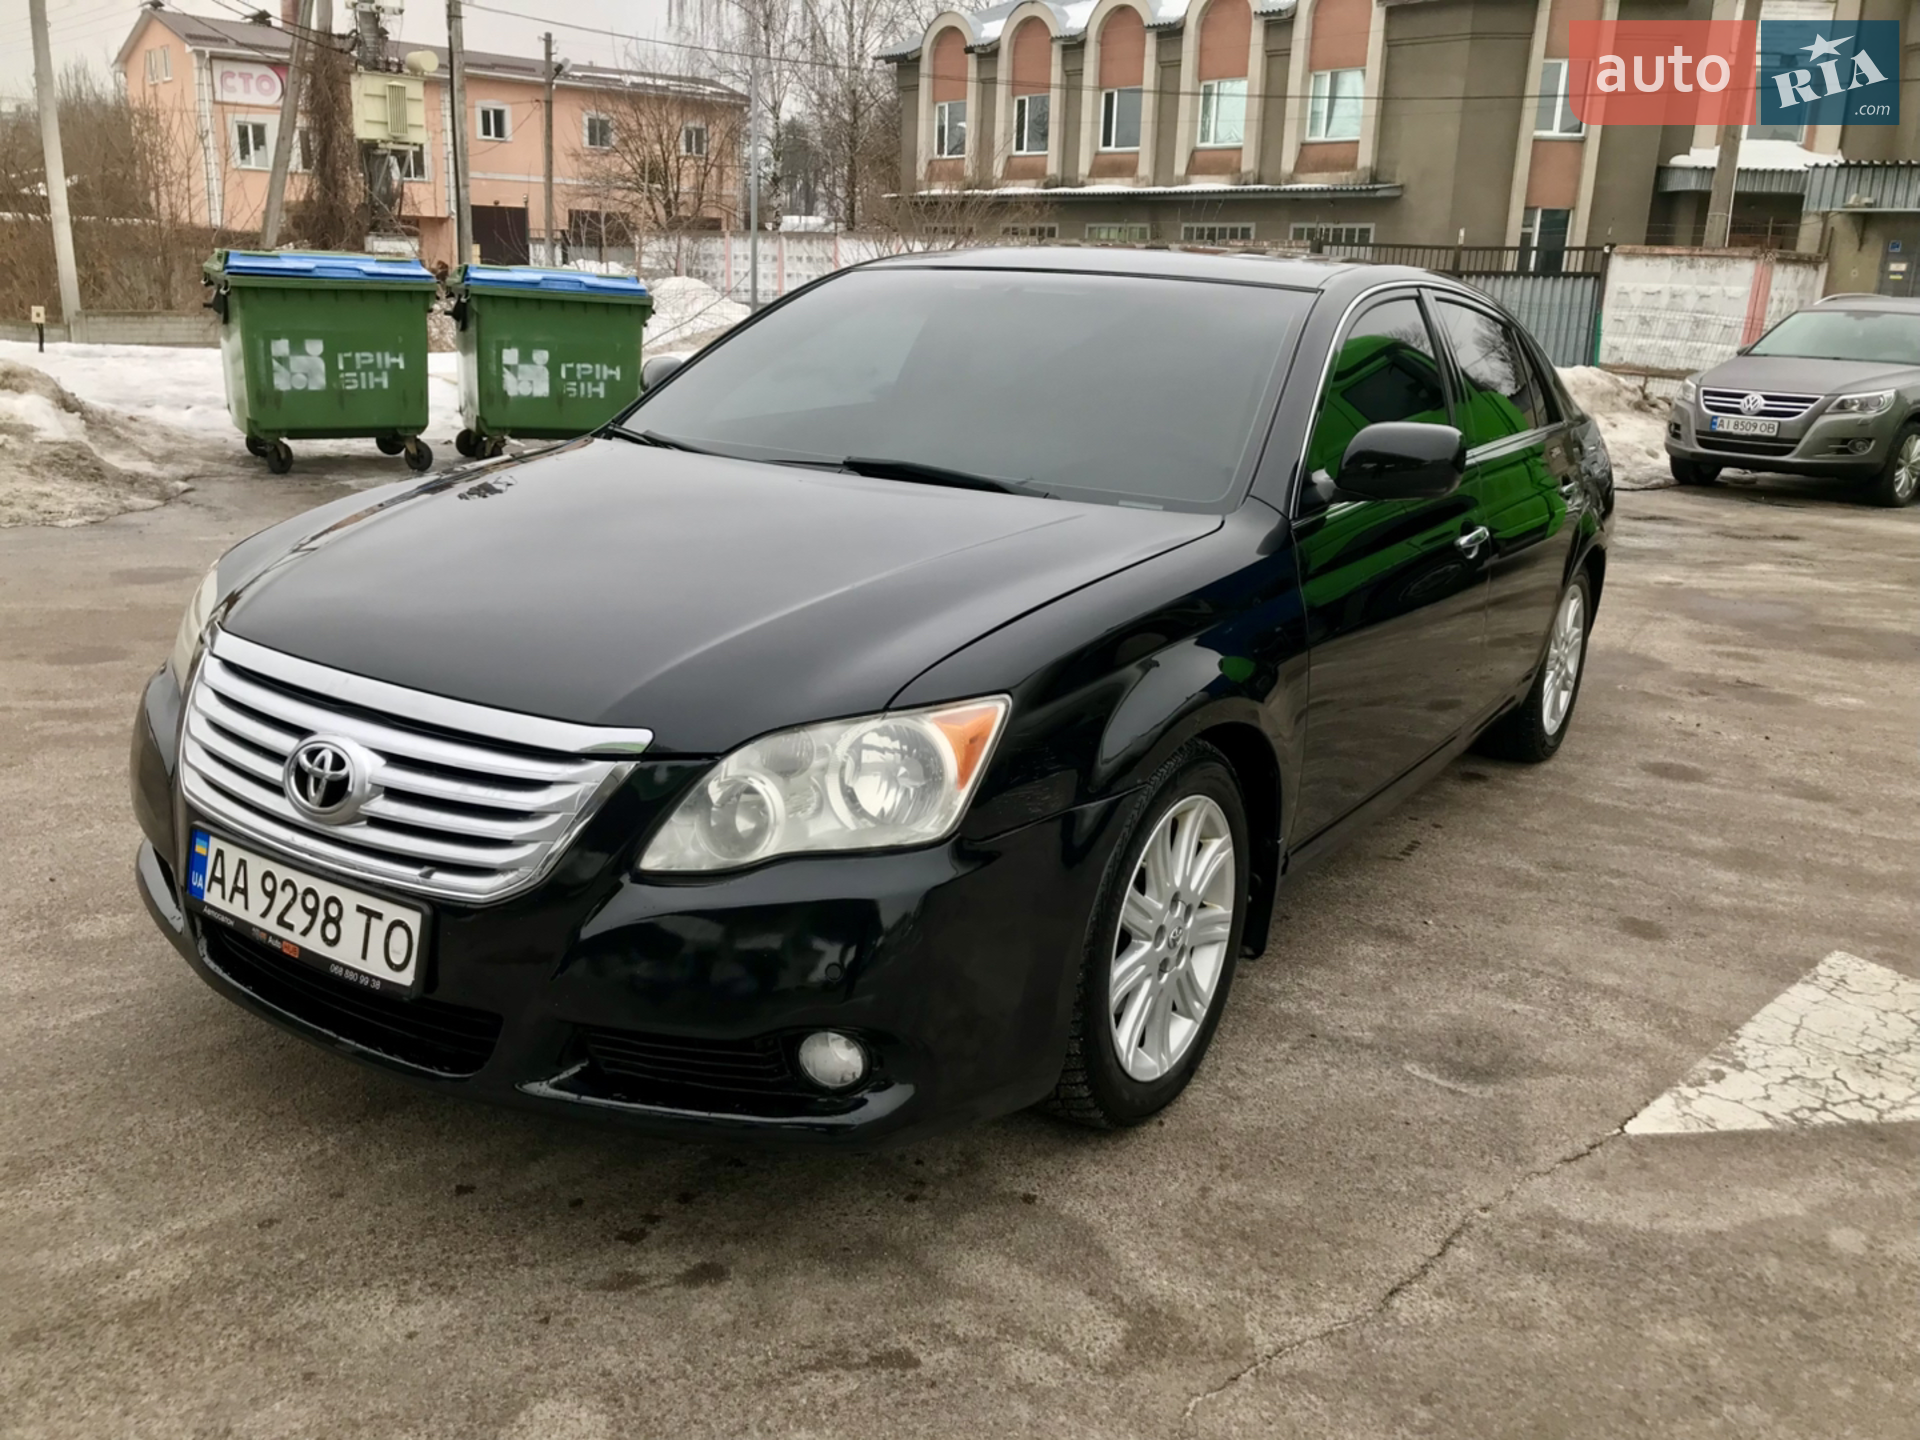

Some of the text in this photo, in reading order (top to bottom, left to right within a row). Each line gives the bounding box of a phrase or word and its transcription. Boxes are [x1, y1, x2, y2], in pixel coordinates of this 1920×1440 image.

[220, 70, 277, 97] СТО
[1718, 418, 1731, 430] AI
[1733, 420, 1758, 433] 8509
[1760, 423, 1776, 434] OB
[191, 870, 204, 890] UA
[206, 847, 414, 973] AA 9298 TO
